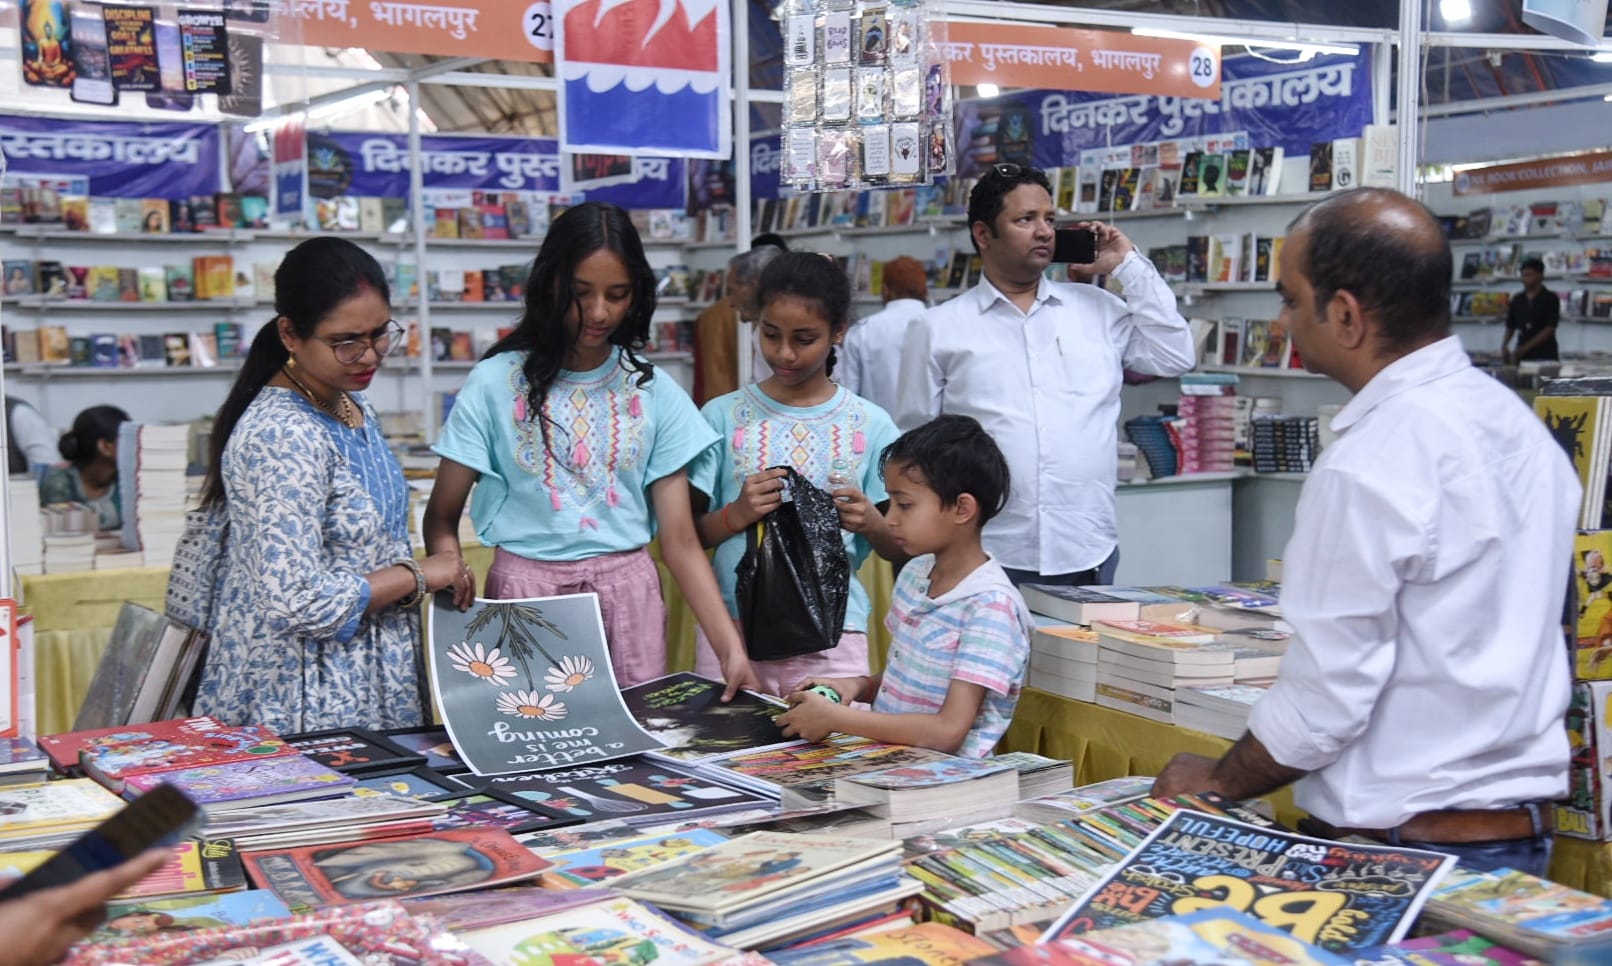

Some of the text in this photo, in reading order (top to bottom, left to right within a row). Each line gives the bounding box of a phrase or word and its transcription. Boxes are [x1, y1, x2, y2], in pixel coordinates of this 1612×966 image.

[370, 2, 479, 39] भागलपुर
[979, 43, 1083, 72] पुस्तकालय,
[1091, 49, 1162, 79] भागलपुर
[1193, 56, 1213, 78] 28
[488, 721, 598, 743] coming
[507, 746, 608, 765] better
[525, 738, 592, 753] me is
[605, 741, 625, 750] a
[1180, 817, 1288, 852] HOPEFUL
[1157, 832, 1288, 877] PRESENT
